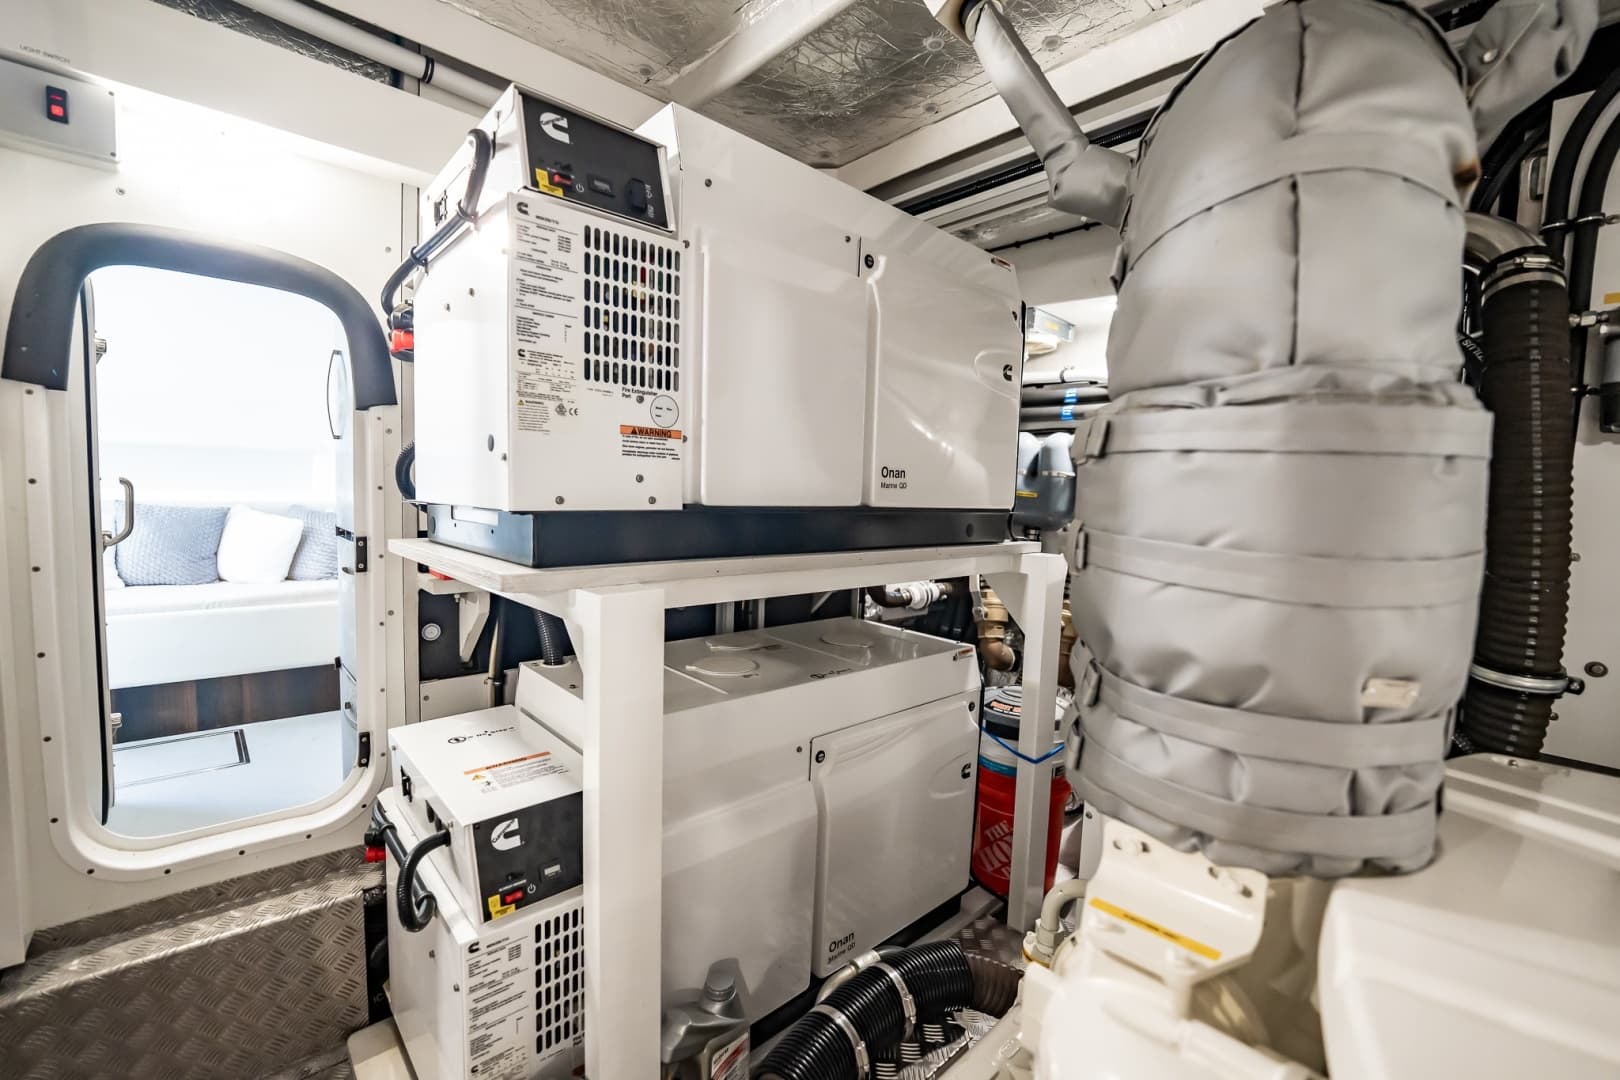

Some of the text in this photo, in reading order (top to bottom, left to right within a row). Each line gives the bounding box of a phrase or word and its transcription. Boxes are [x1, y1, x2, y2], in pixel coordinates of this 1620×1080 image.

[637, 427, 672, 438] WARNING
[881, 466, 906, 479] Onan
[828, 932, 855, 953] Onan
